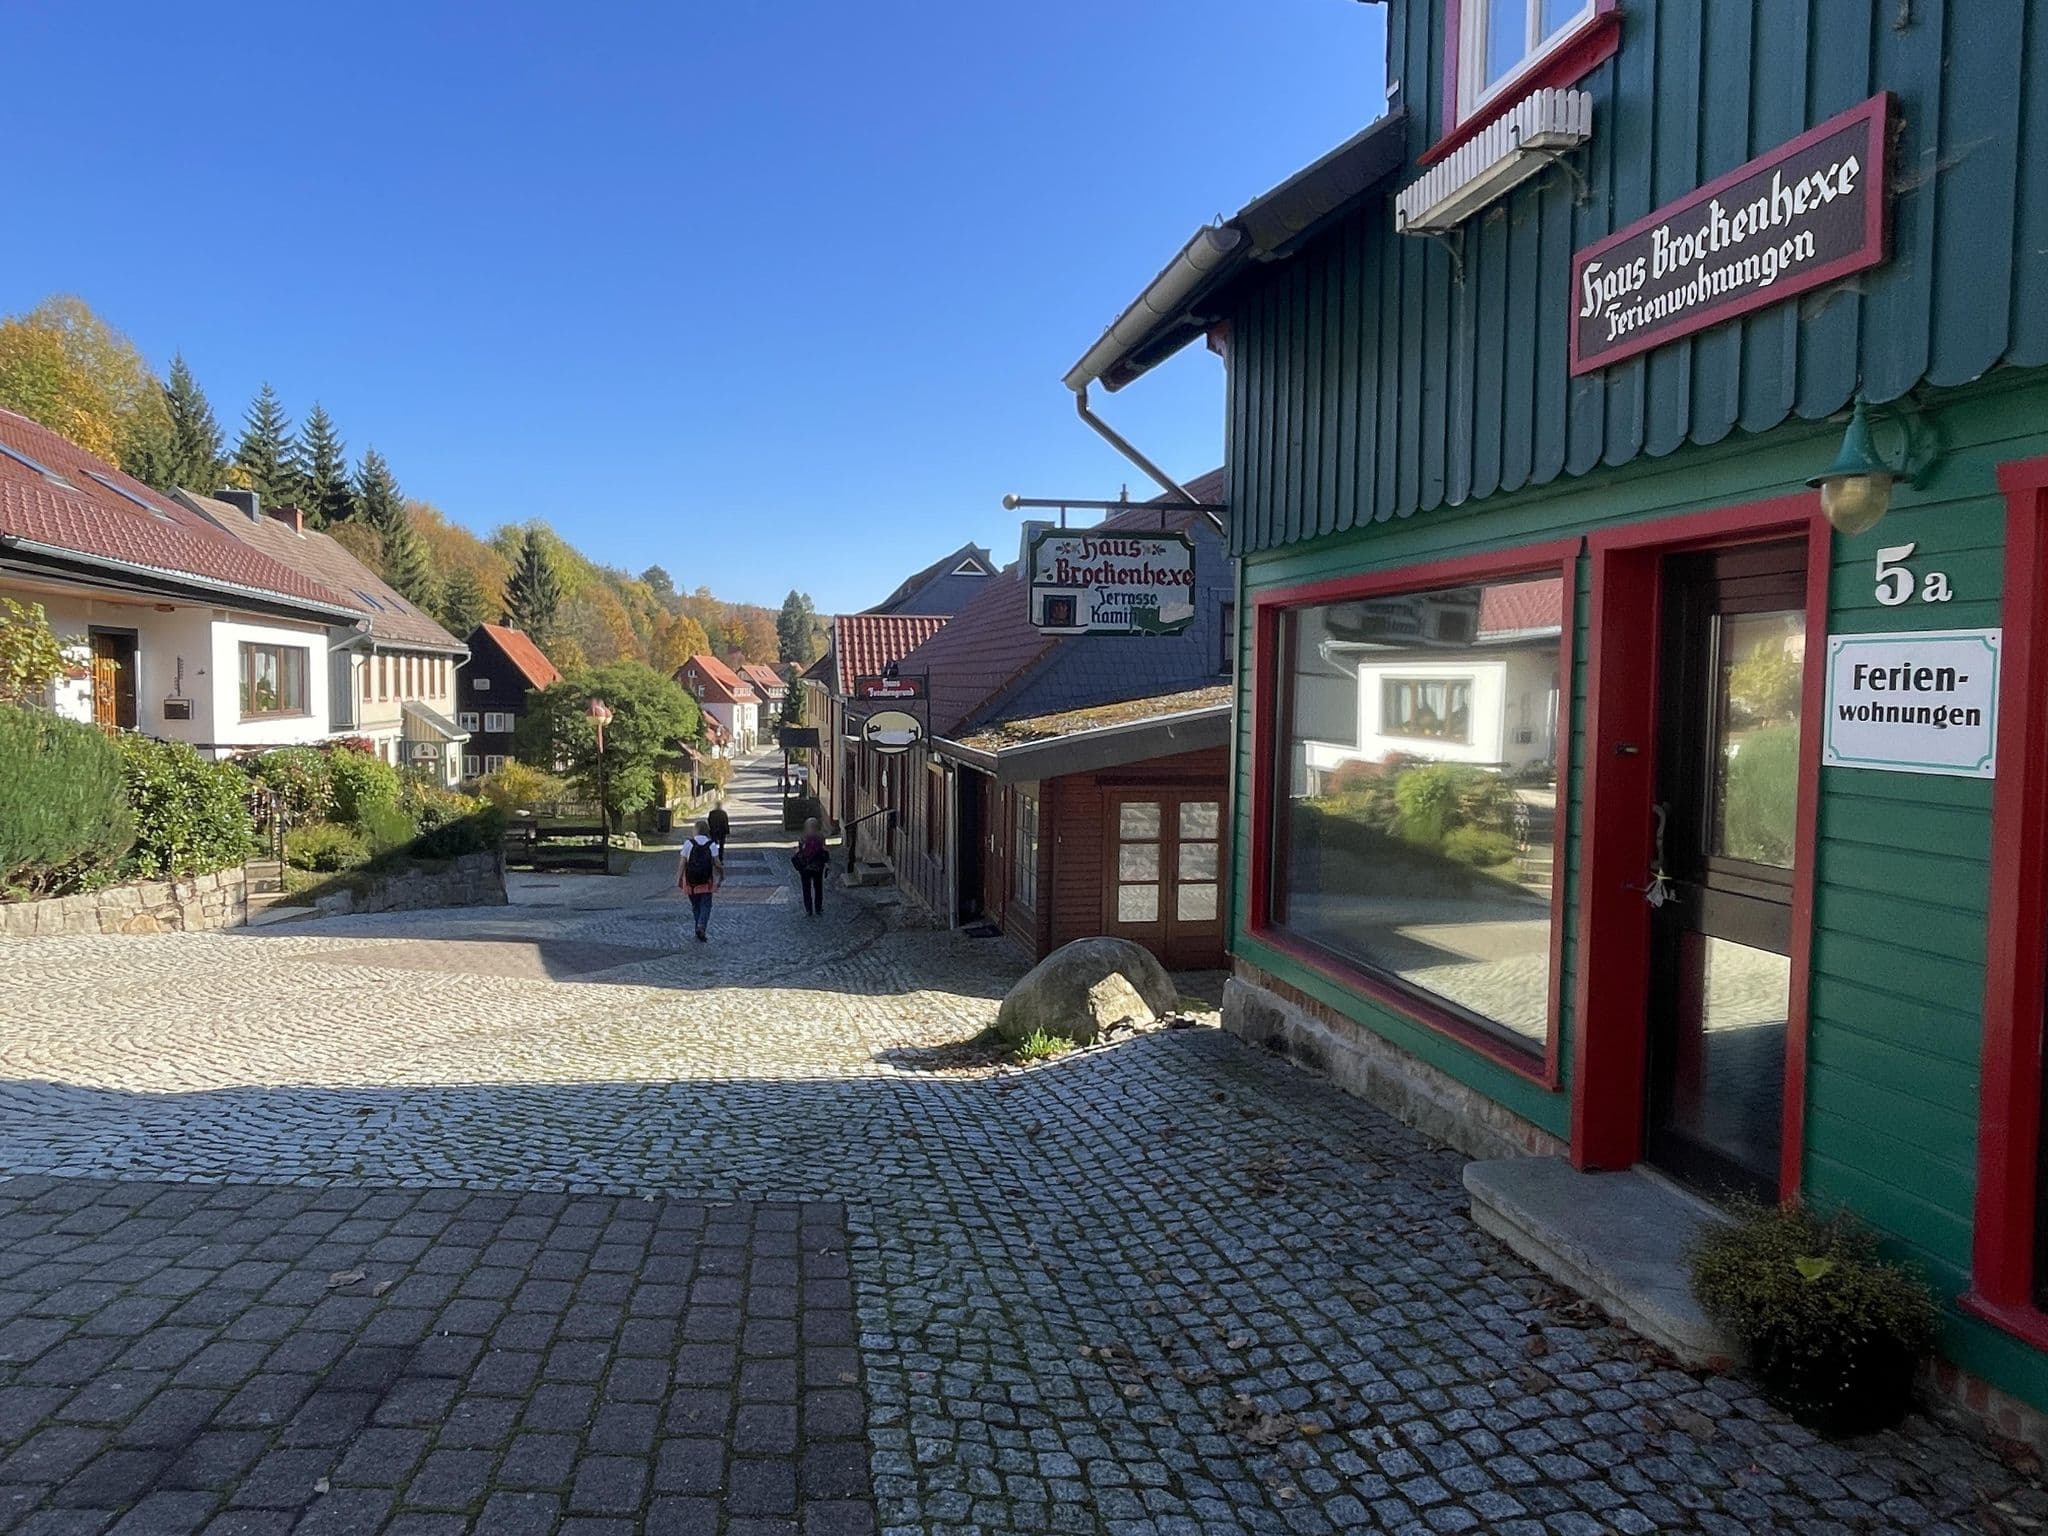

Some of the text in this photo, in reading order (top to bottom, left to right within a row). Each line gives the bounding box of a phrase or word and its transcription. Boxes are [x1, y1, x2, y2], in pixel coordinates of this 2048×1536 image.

[1580, 155, 1861, 319] Haus Brockenhexe
[1605, 229, 1816, 342] Ferienwohnungen
[1078, 533, 1142, 561] Haus
[1055, 557, 1195, 587] Brockenhexe
[1095, 586, 1158, 606] Terrasse
[1853, 662, 1969, 691] Ferien-
[1839, 702, 1981, 729] wohnungen
